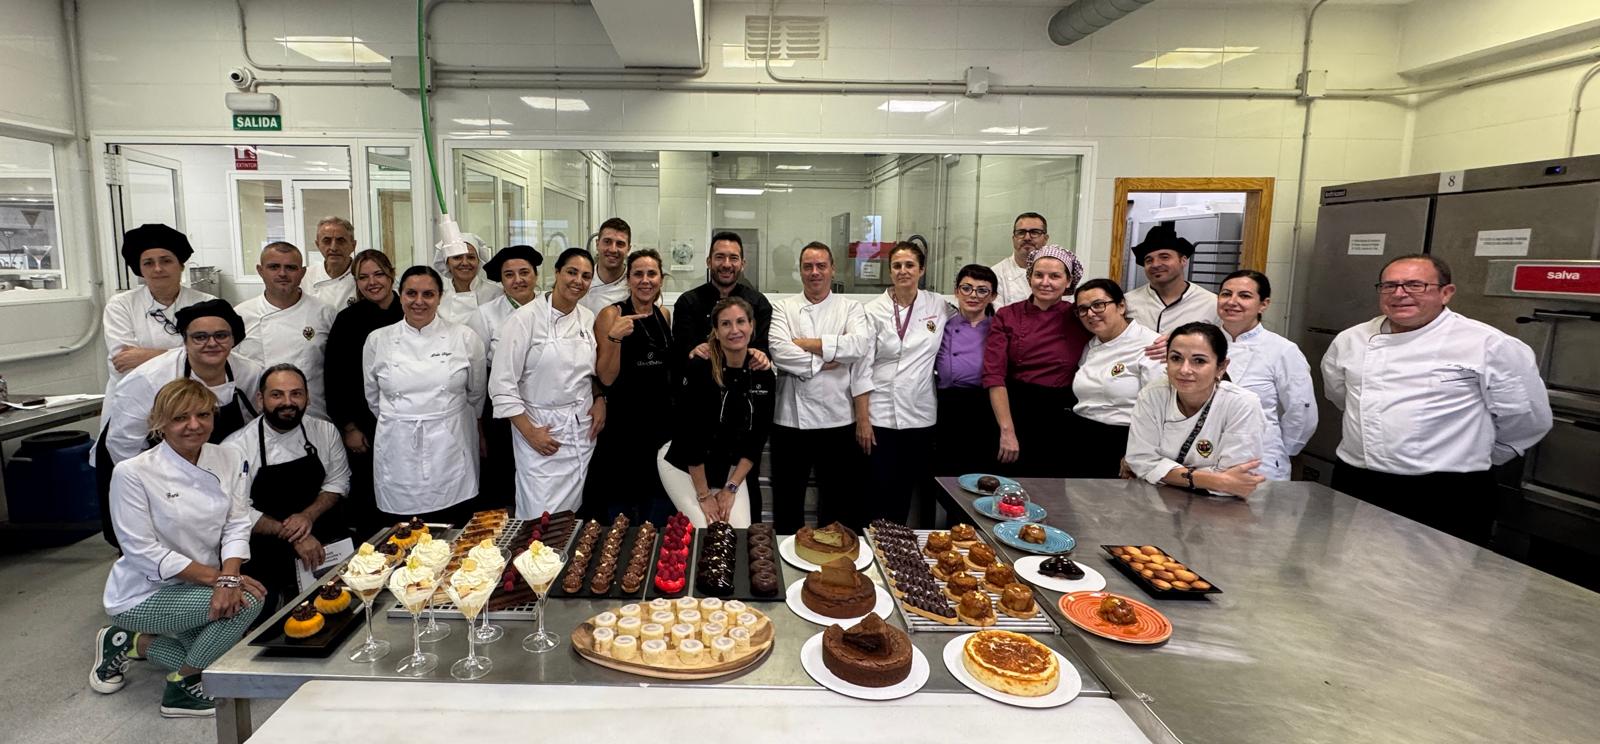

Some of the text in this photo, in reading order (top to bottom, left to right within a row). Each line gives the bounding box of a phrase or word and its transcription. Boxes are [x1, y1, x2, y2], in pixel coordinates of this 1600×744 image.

[236, 116, 278, 128] SALIDA
[1447, 175, 1456, 188] 8
[1546, 270, 1580, 280] salva
